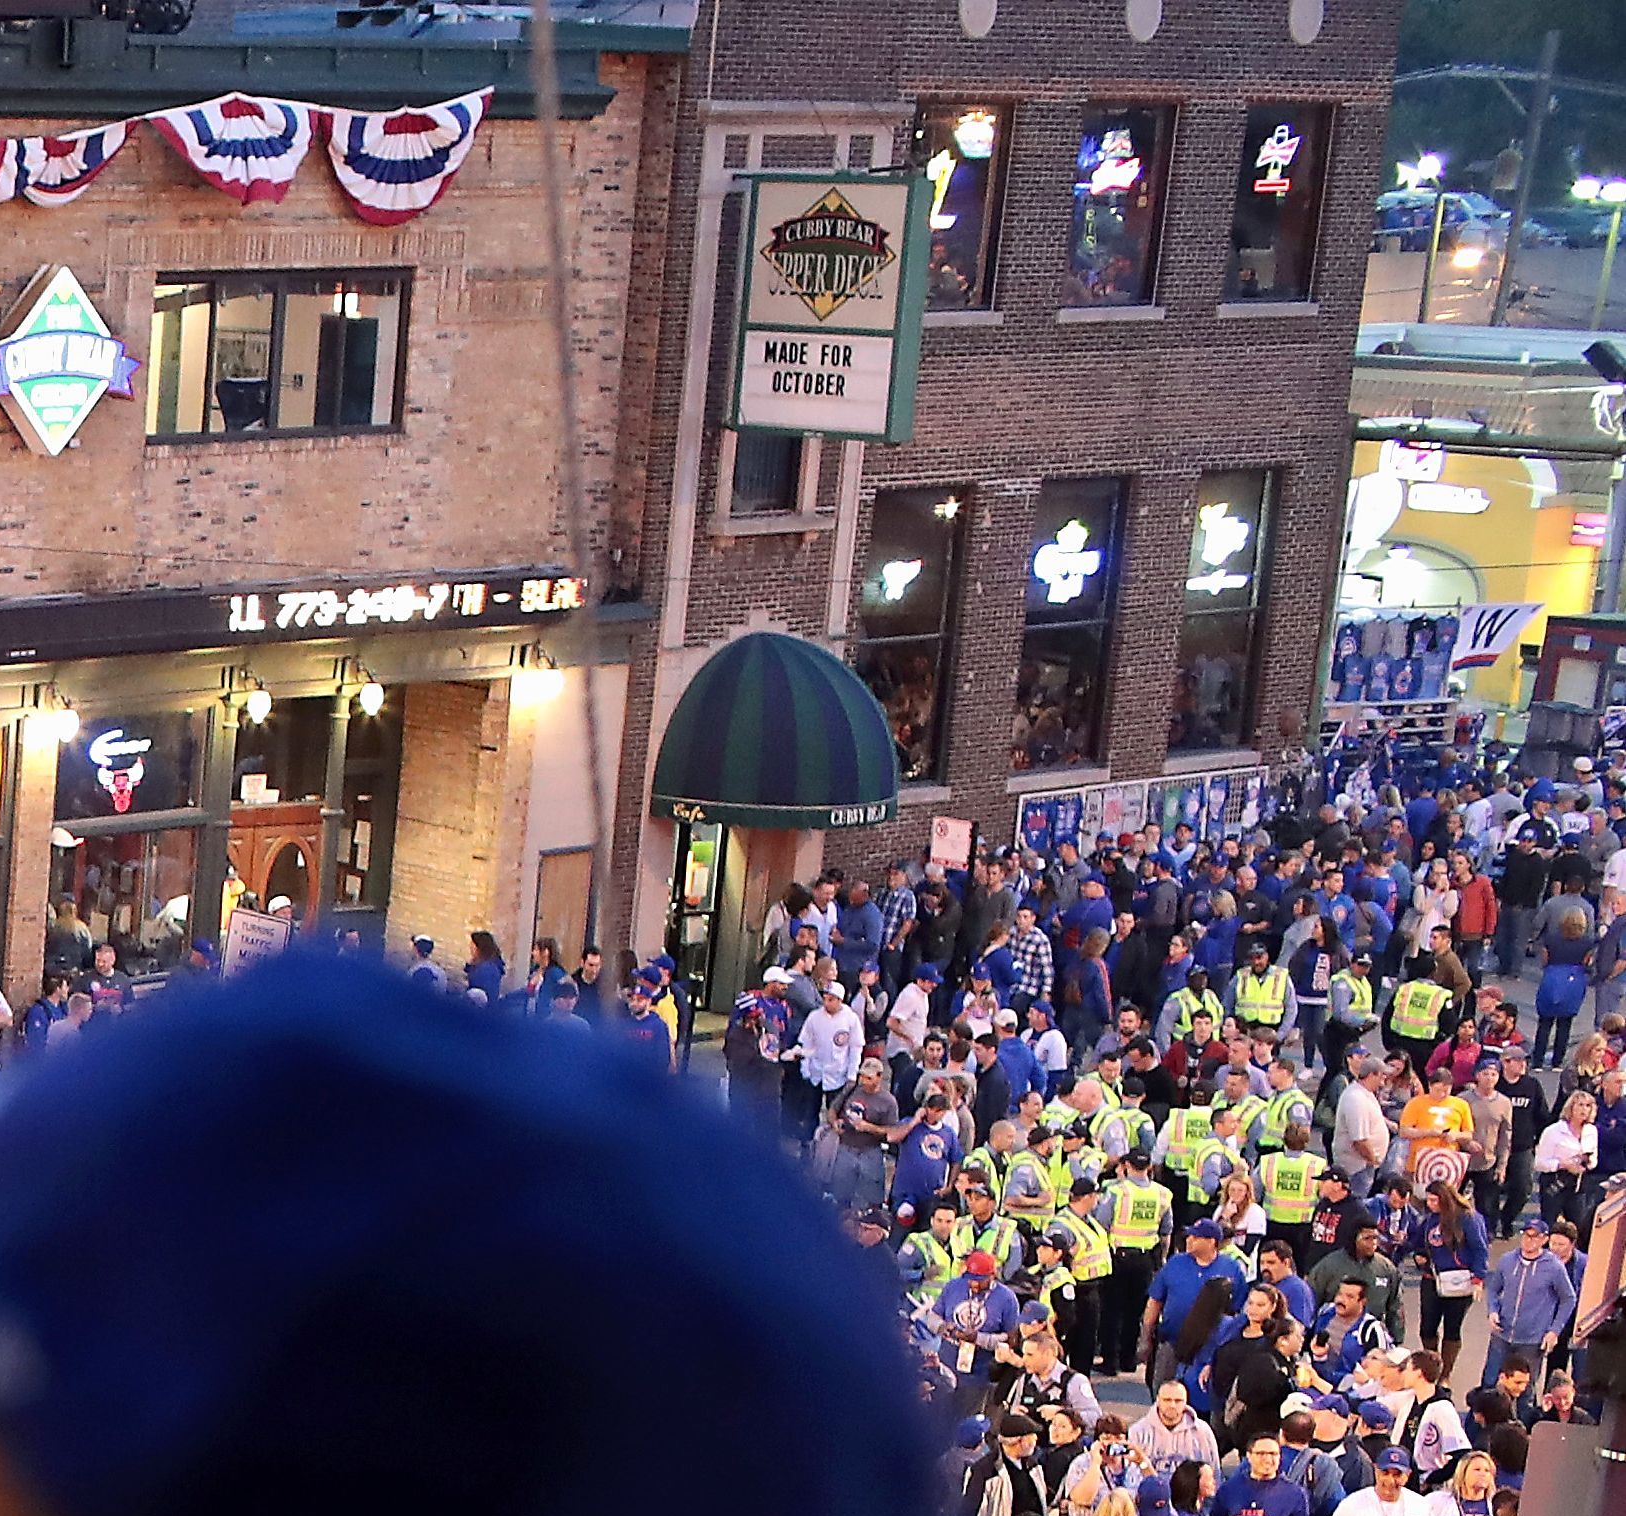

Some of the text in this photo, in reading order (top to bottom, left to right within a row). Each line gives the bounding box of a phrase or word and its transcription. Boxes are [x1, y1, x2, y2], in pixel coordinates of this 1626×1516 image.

[785, 219, 875, 246] CUBBY BEAR
[833, 253, 886, 299] DECK
[764, 340, 853, 367] MADE FOR
[772, 371, 846, 397] OCTOBER
[1469, 607, 1519, 650] W
